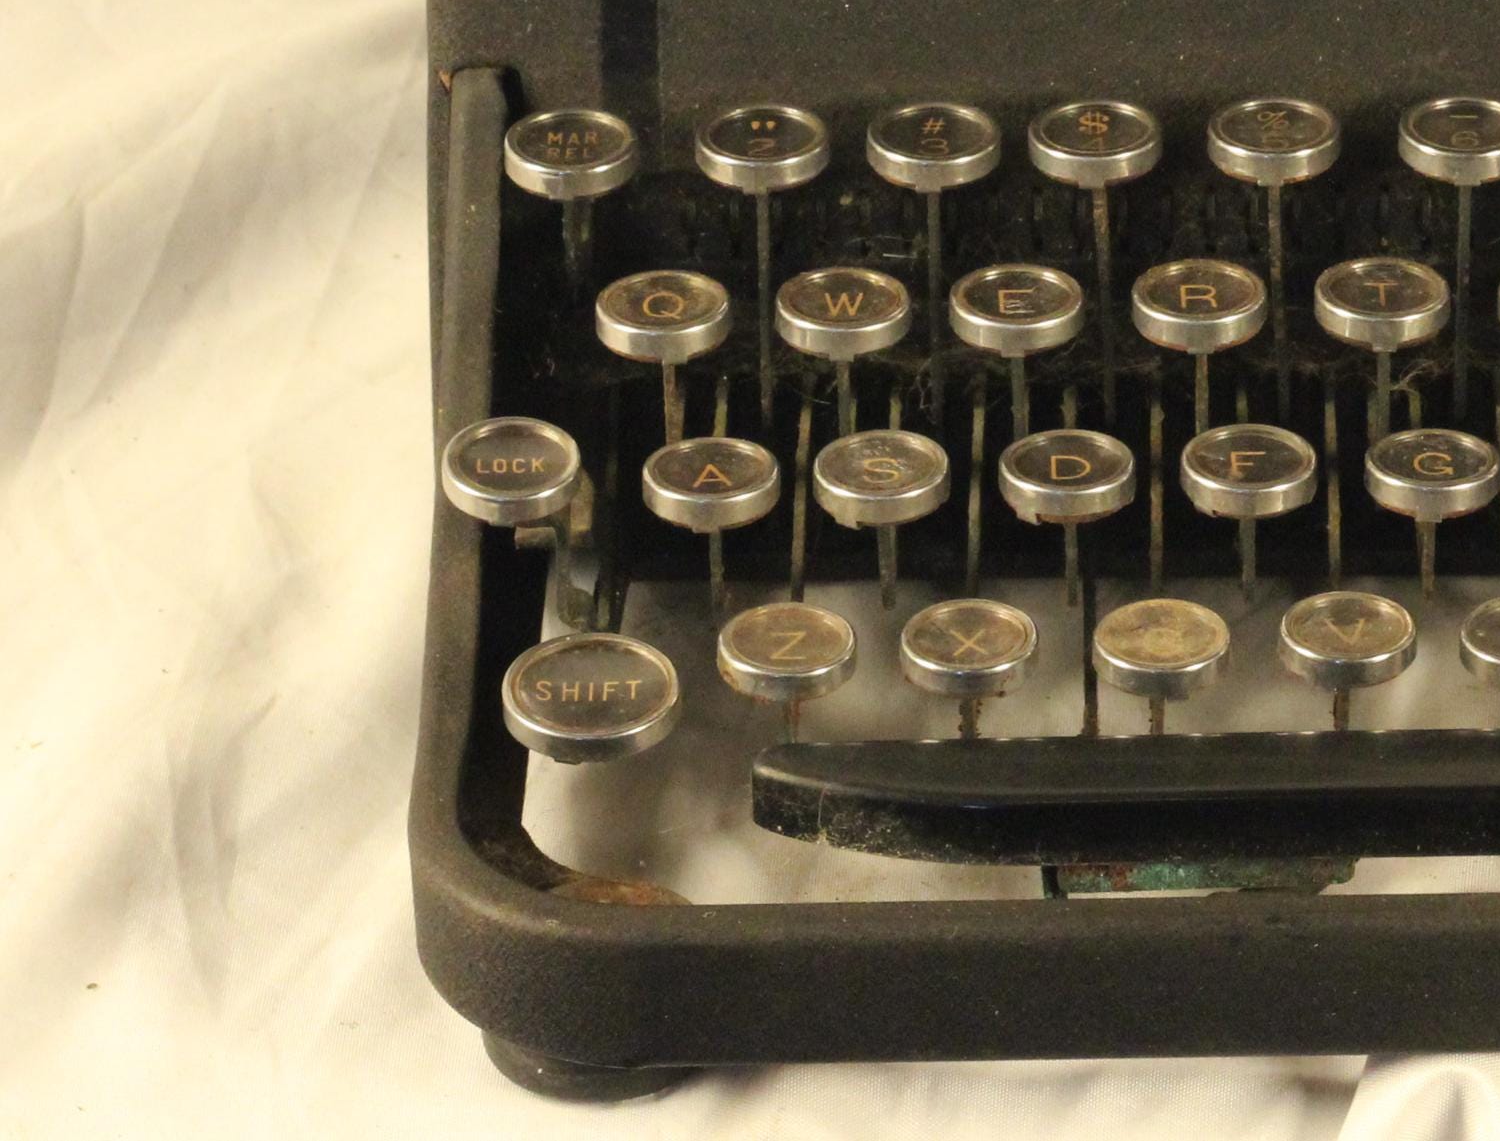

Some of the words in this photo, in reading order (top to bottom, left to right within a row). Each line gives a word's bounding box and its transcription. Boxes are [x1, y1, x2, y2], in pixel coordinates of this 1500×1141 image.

[921, 118, 946, 134] #
[1078, 111, 1109, 135] $
[1256, 110, 1290, 130] %
[546, 131, 599, 145] MAR
[747, 138, 777, 157] 2
[920, 139, 949, 156] 3
[1450, 130, 1480, 148] 6
[641, 290, 686, 321] Q
[824, 292, 864, 317] W
[997, 287, 1038, 314] E
[1179, 284, 1217, 308] R
[1363, 281, 1399, 307] T
[476, 457, 546, 475] LOCK
[692, 463, 733, 488] A
[861, 457, 902, 484] S
[1050, 455, 1092, 481] D
[1229, 450, 1267, 477] F
[1412, 451, 1454, 476] G
[950, 628, 988, 657] X
[1324, 617, 1366, 645] V
[769, 630, 807, 660] Z
[534, 679, 643, 703] SHIFT
